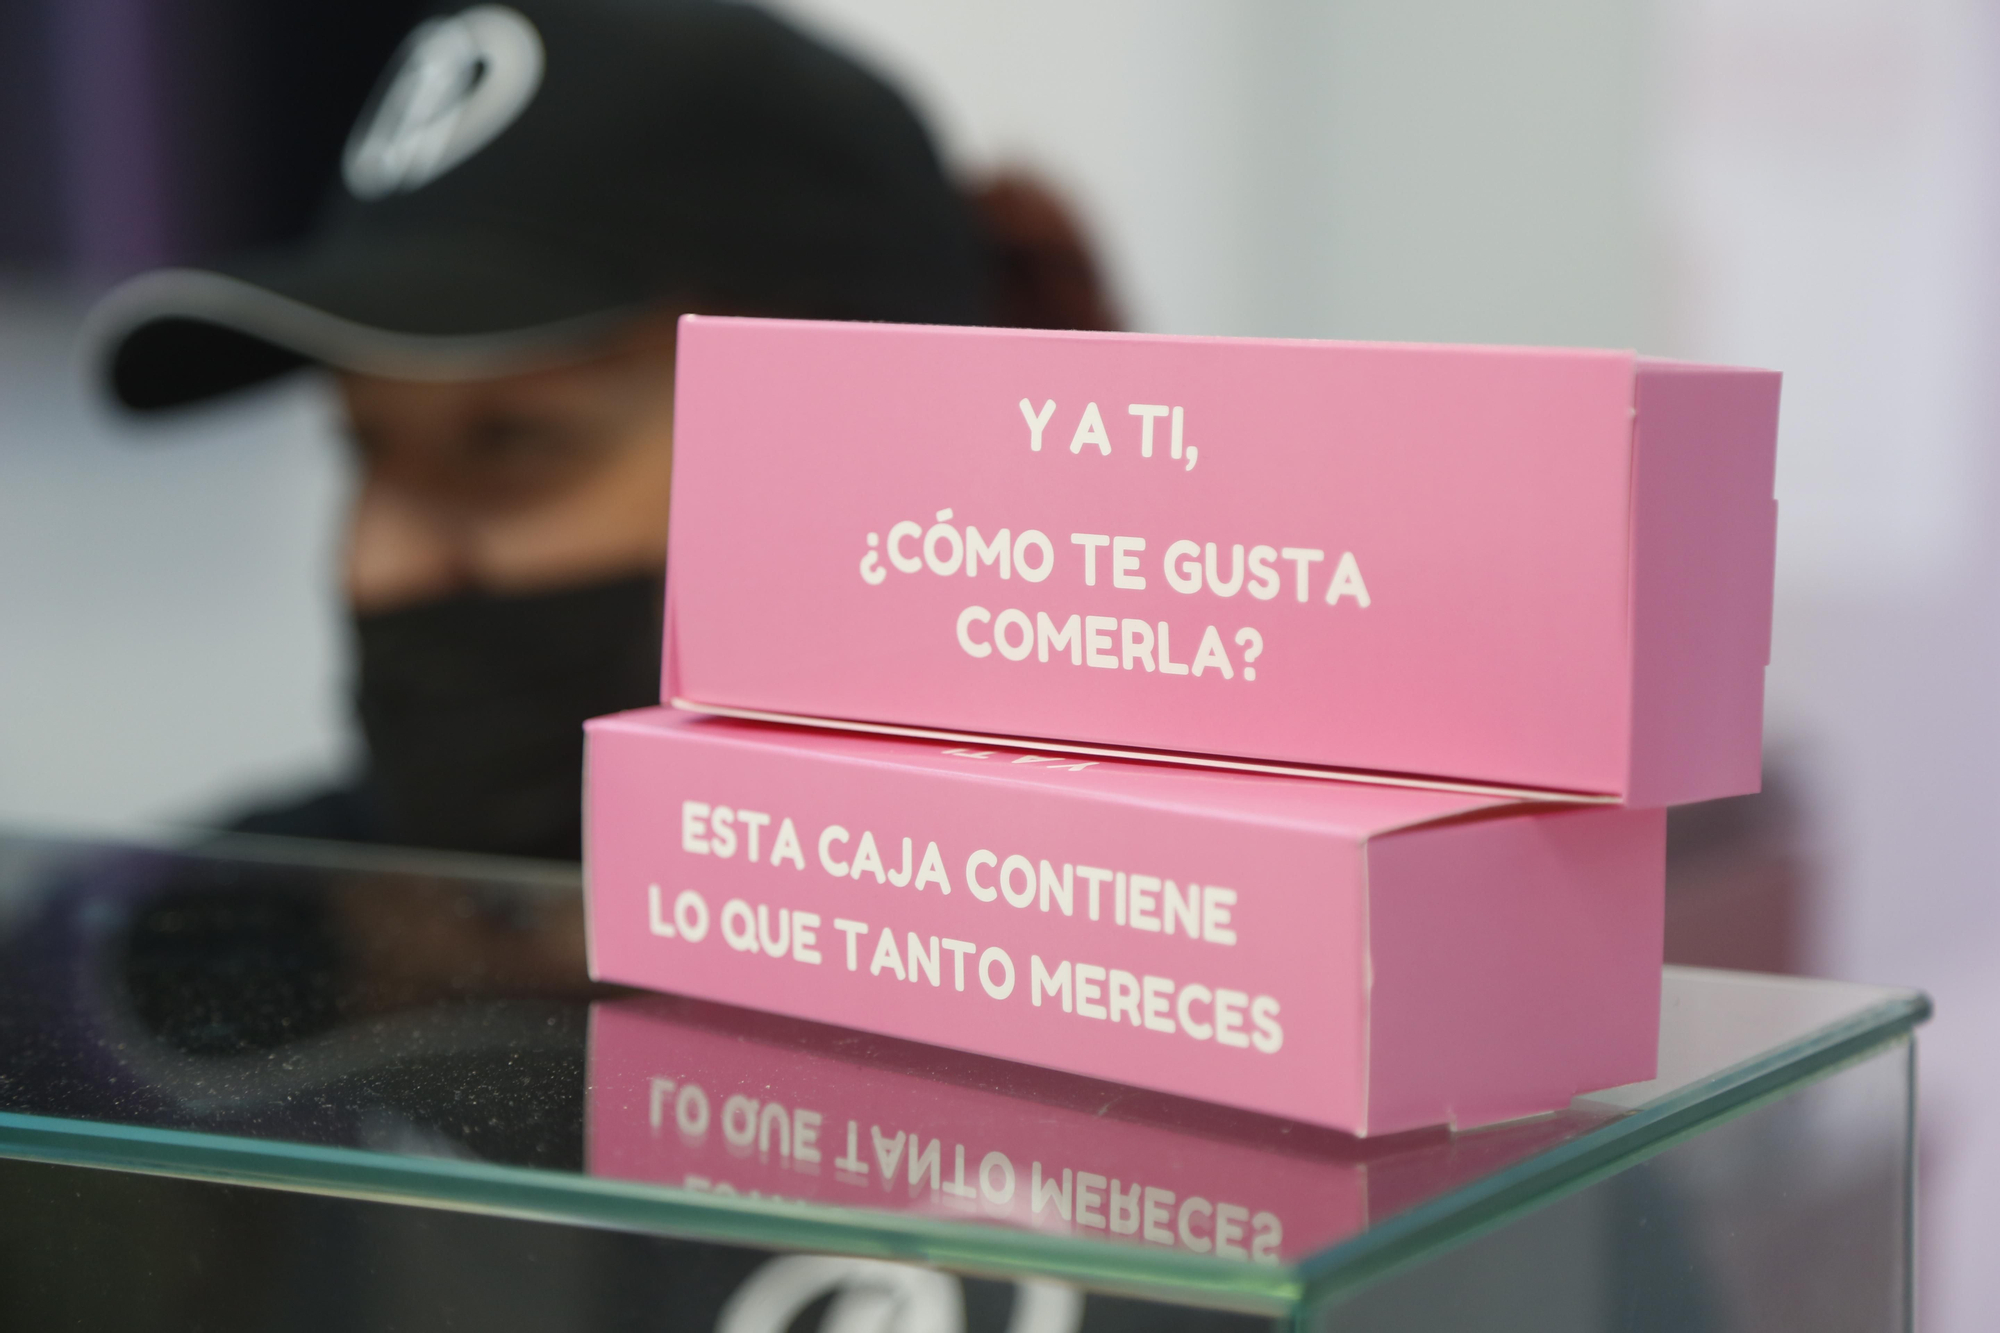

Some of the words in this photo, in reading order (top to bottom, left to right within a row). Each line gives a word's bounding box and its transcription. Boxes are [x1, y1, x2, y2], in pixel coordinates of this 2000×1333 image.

[1018, 397, 1057, 452] Y
[1069, 401, 1112, 456] A
[1127, 403, 1199, 472] TI,
[859, 507, 1055, 586] ¿CÓMO
[1070, 532, 1147, 590] TE
[1163, 539, 1371, 608] GUSTA
[956, 605, 1264, 682] COMERLA?
[682, 801, 805, 870] ESTA
[818, 825, 952, 896] CAJA
[965, 849, 1237, 945] CONTIENE
[649, 886, 709, 942] LO
[721, 899, 822, 965] QUE
[834, 918, 1016, 1000] TANTO
[1030, 954, 1283, 1053] MERECES
